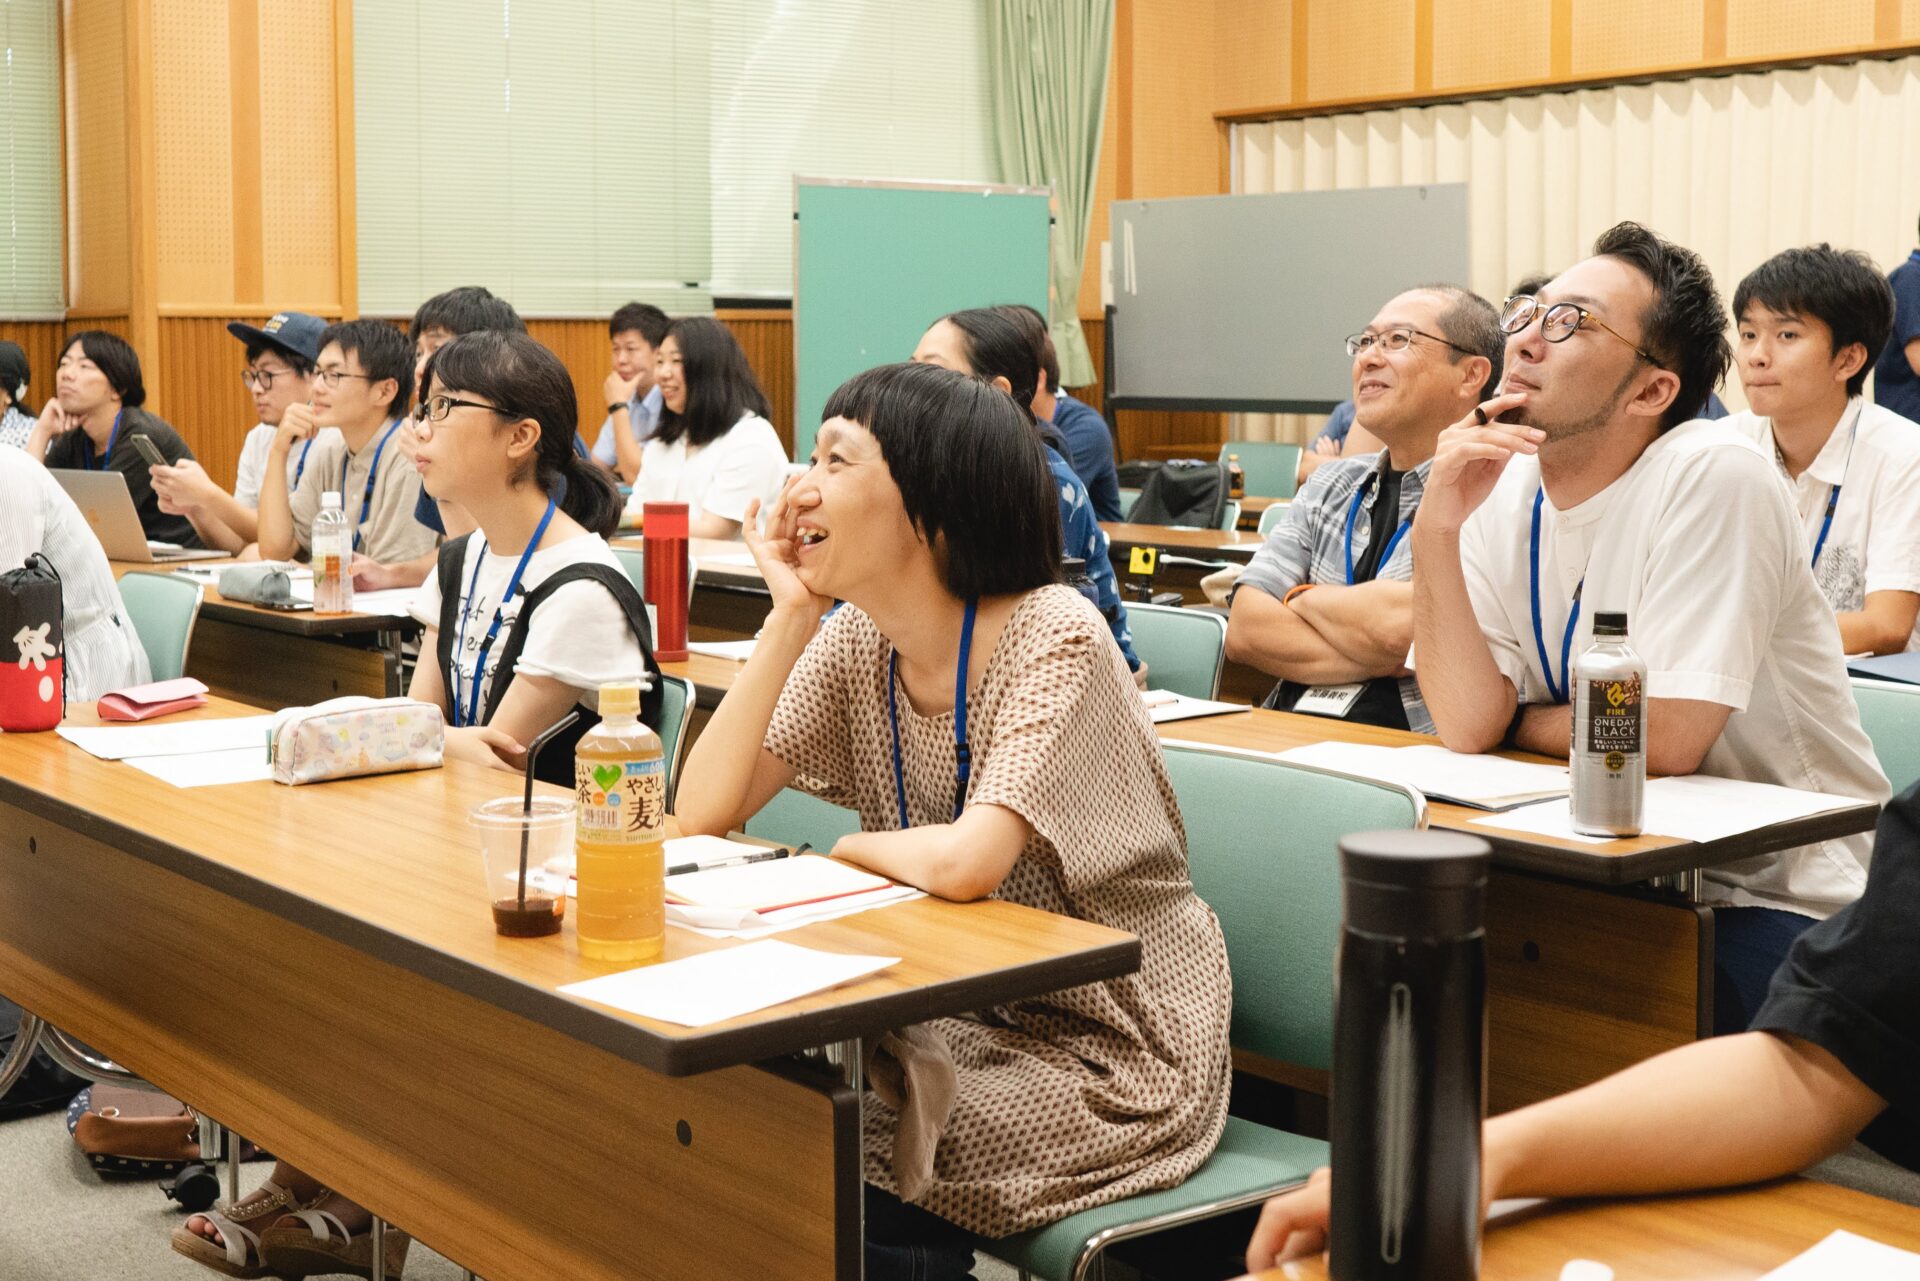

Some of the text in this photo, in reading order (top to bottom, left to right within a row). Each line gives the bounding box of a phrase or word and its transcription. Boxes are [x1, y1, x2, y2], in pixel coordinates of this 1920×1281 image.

[1606, 708, 1626, 716] FIRE
[1594, 718, 1636, 727] ONEDAY
[1594, 726, 1636, 736] BLACK
